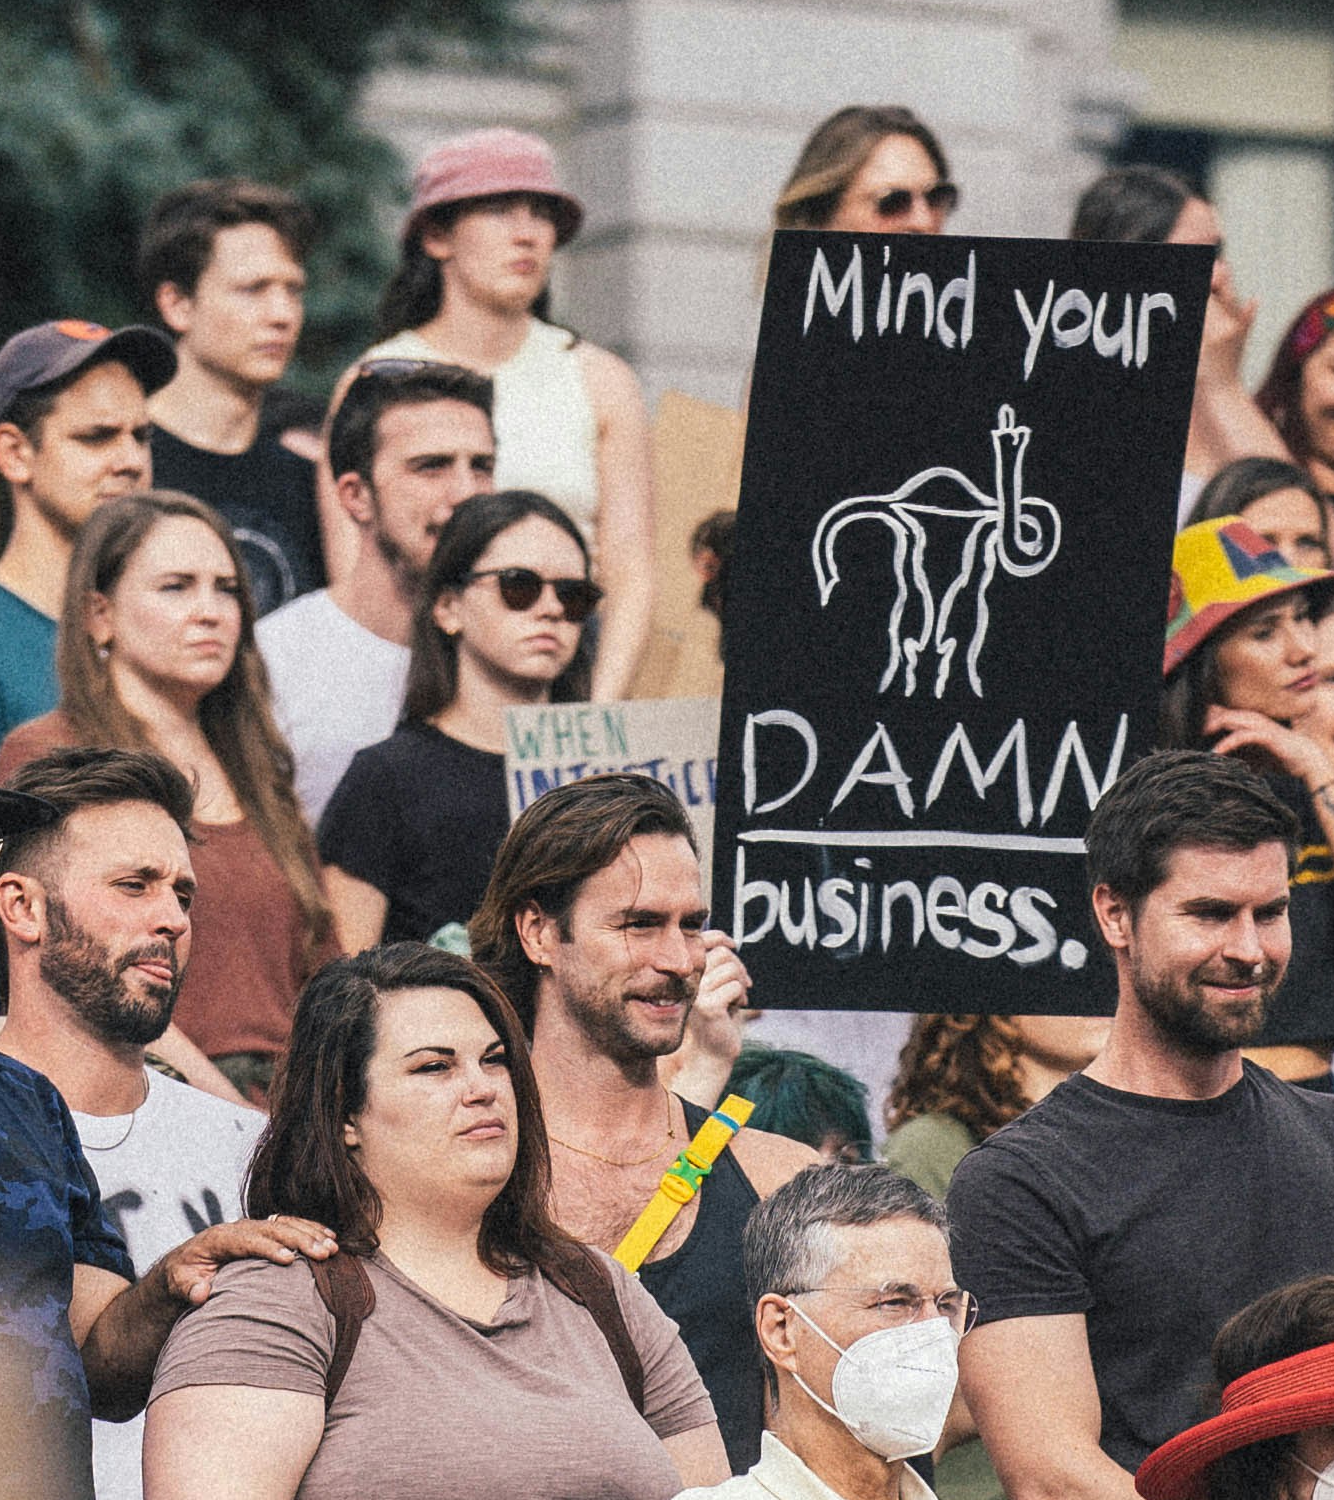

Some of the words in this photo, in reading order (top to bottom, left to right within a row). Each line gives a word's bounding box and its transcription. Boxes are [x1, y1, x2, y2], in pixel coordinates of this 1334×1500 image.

[802, 244, 978, 351] Mind
[1013, 278, 1177, 381] your
[505, 708, 628, 761] WHEN
[739, 707, 1130, 828] DAMN
[732, 842, 1090, 970] business.
